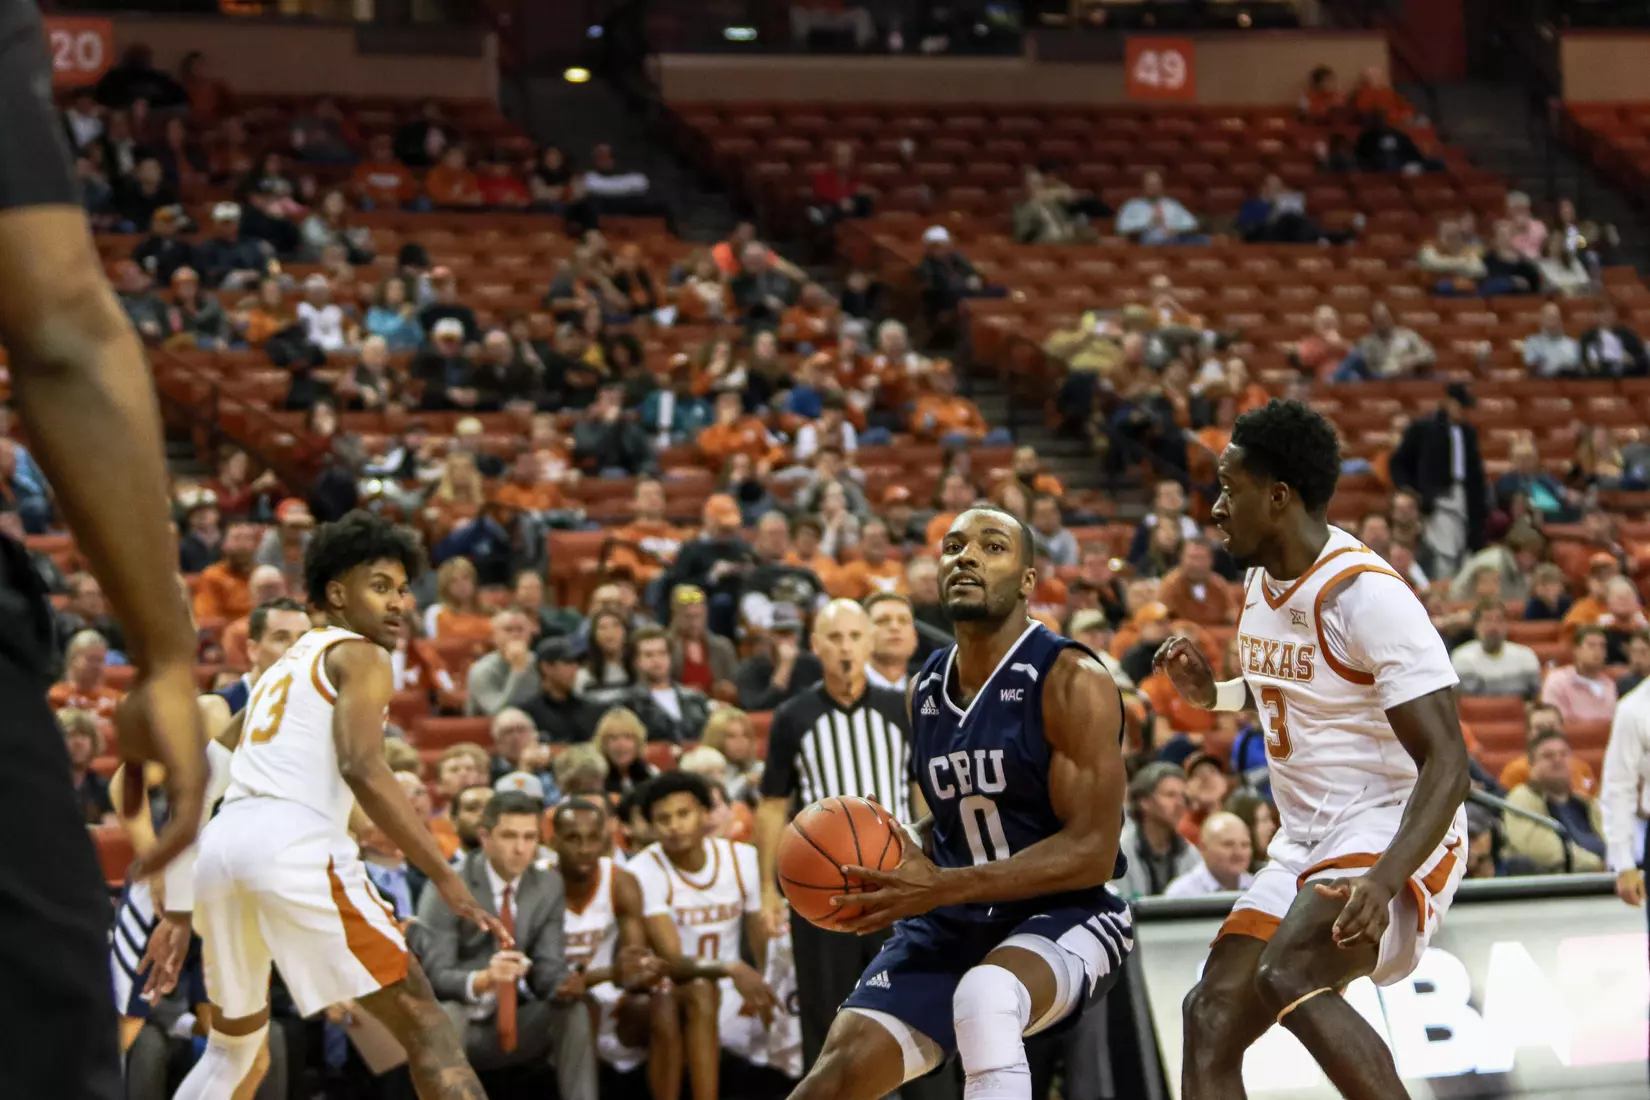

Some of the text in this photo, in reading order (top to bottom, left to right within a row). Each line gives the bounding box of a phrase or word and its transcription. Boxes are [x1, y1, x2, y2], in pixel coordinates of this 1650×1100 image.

[50, 31, 103, 69] 20
[1133, 50, 1187, 88] 49
[1240, 633, 1316, 682] TEXAS
[240, 673, 293, 747] 13
[1000, 689, 1024, 702] WAC
[1261, 685, 1293, 761] 3
[928, 749, 1007, 800] CBU
[959, 794, 1010, 866] 0
